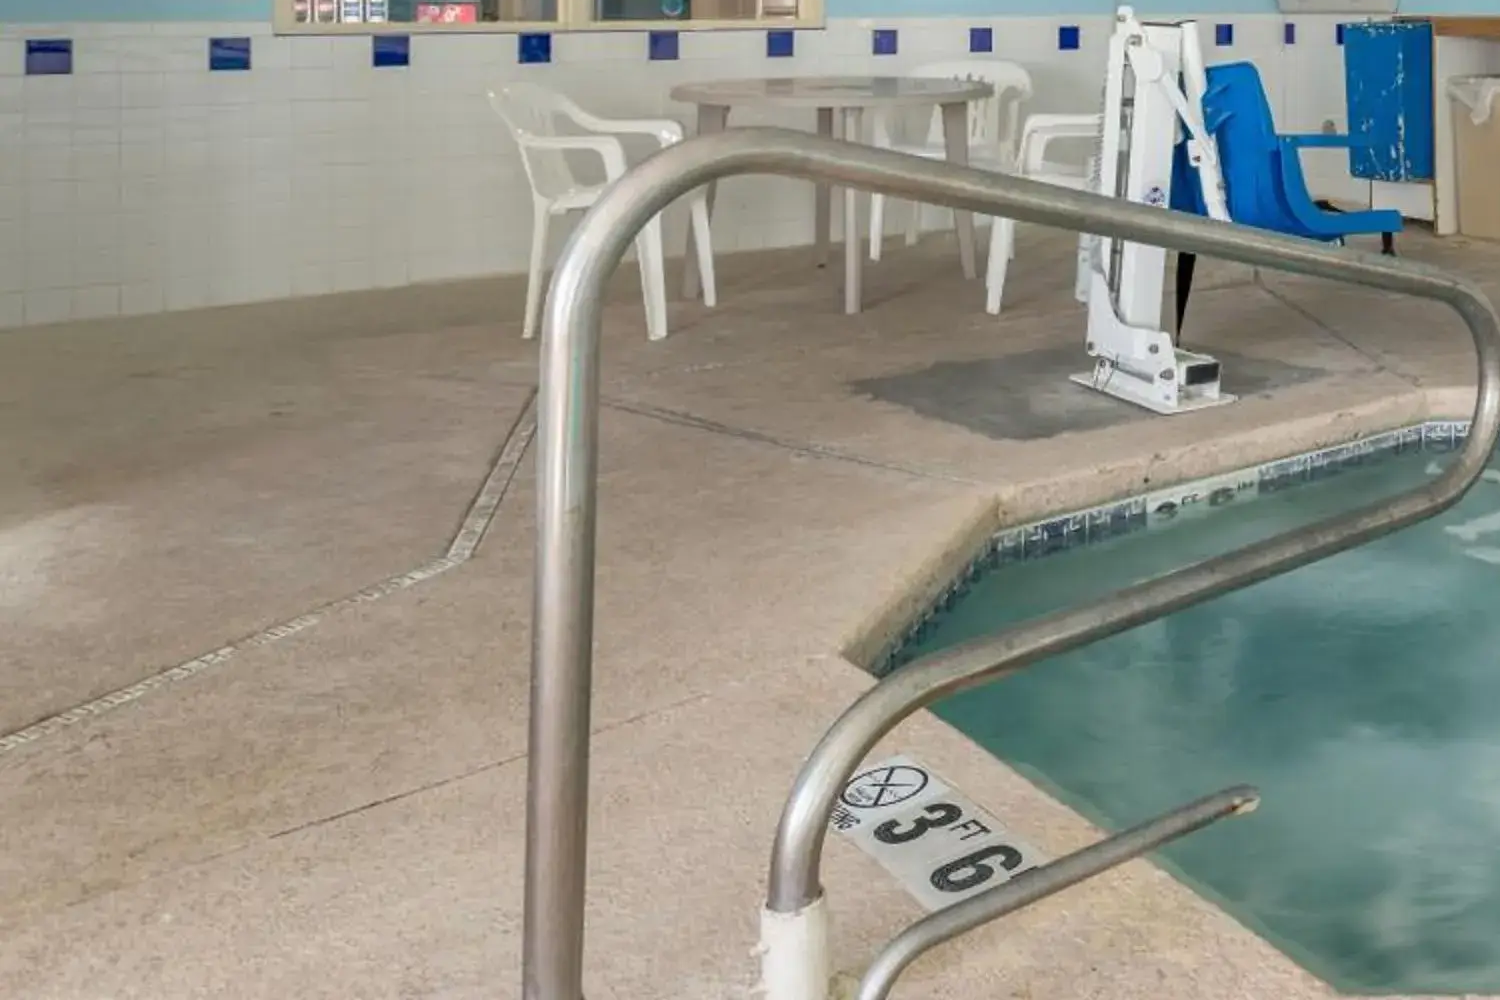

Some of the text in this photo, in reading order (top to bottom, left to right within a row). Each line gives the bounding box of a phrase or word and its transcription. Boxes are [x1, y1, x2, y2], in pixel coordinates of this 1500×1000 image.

[873, 803, 963, 845] 3
[948, 819, 993, 841] FT
[929, 844, 1023, 893] 6
